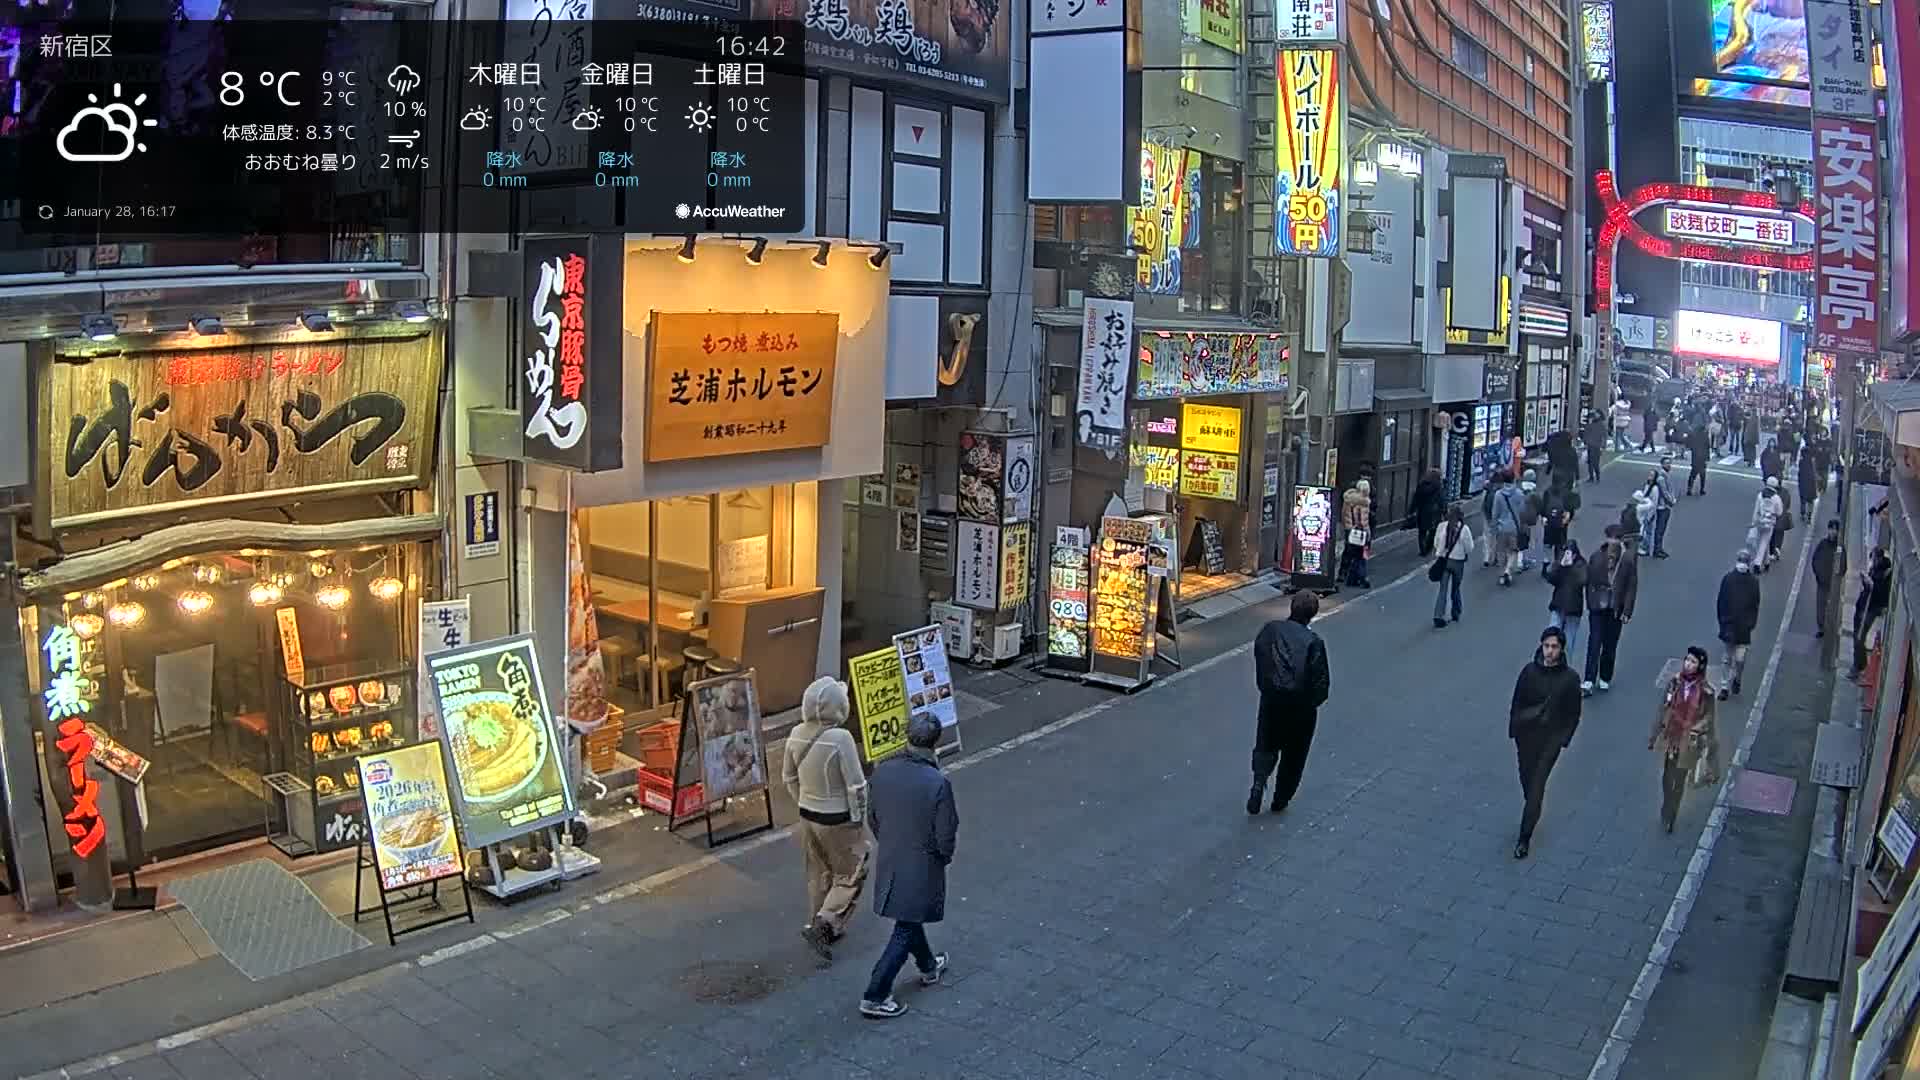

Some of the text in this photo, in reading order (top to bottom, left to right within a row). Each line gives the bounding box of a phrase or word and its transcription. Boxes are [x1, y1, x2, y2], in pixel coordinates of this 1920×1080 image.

[1588, 64, 1610, 80] 7F
[1818, 84, 1868, 96] RESTAURANT
[1294, 54, 1321, 190] ハイボール
[1832, 97, 1855, 112] 3F
[1670, 211, 1790, 242] 歌舞伎町一番街
[1819, 127, 1876, 330] 安楽亭
[561, 254, 585, 400] 東京豚骨
[1818, 332, 1836, 347] 2F
[1097, 309, 1128, 416] お好み焼き
[668, 366, 823, 406] 芝浦ホルモン
[970, 526, 984, 600] 芝浦ホルモン
[499, 655, 537, 719] 角煮
[869, 716, 900, 745] 290
